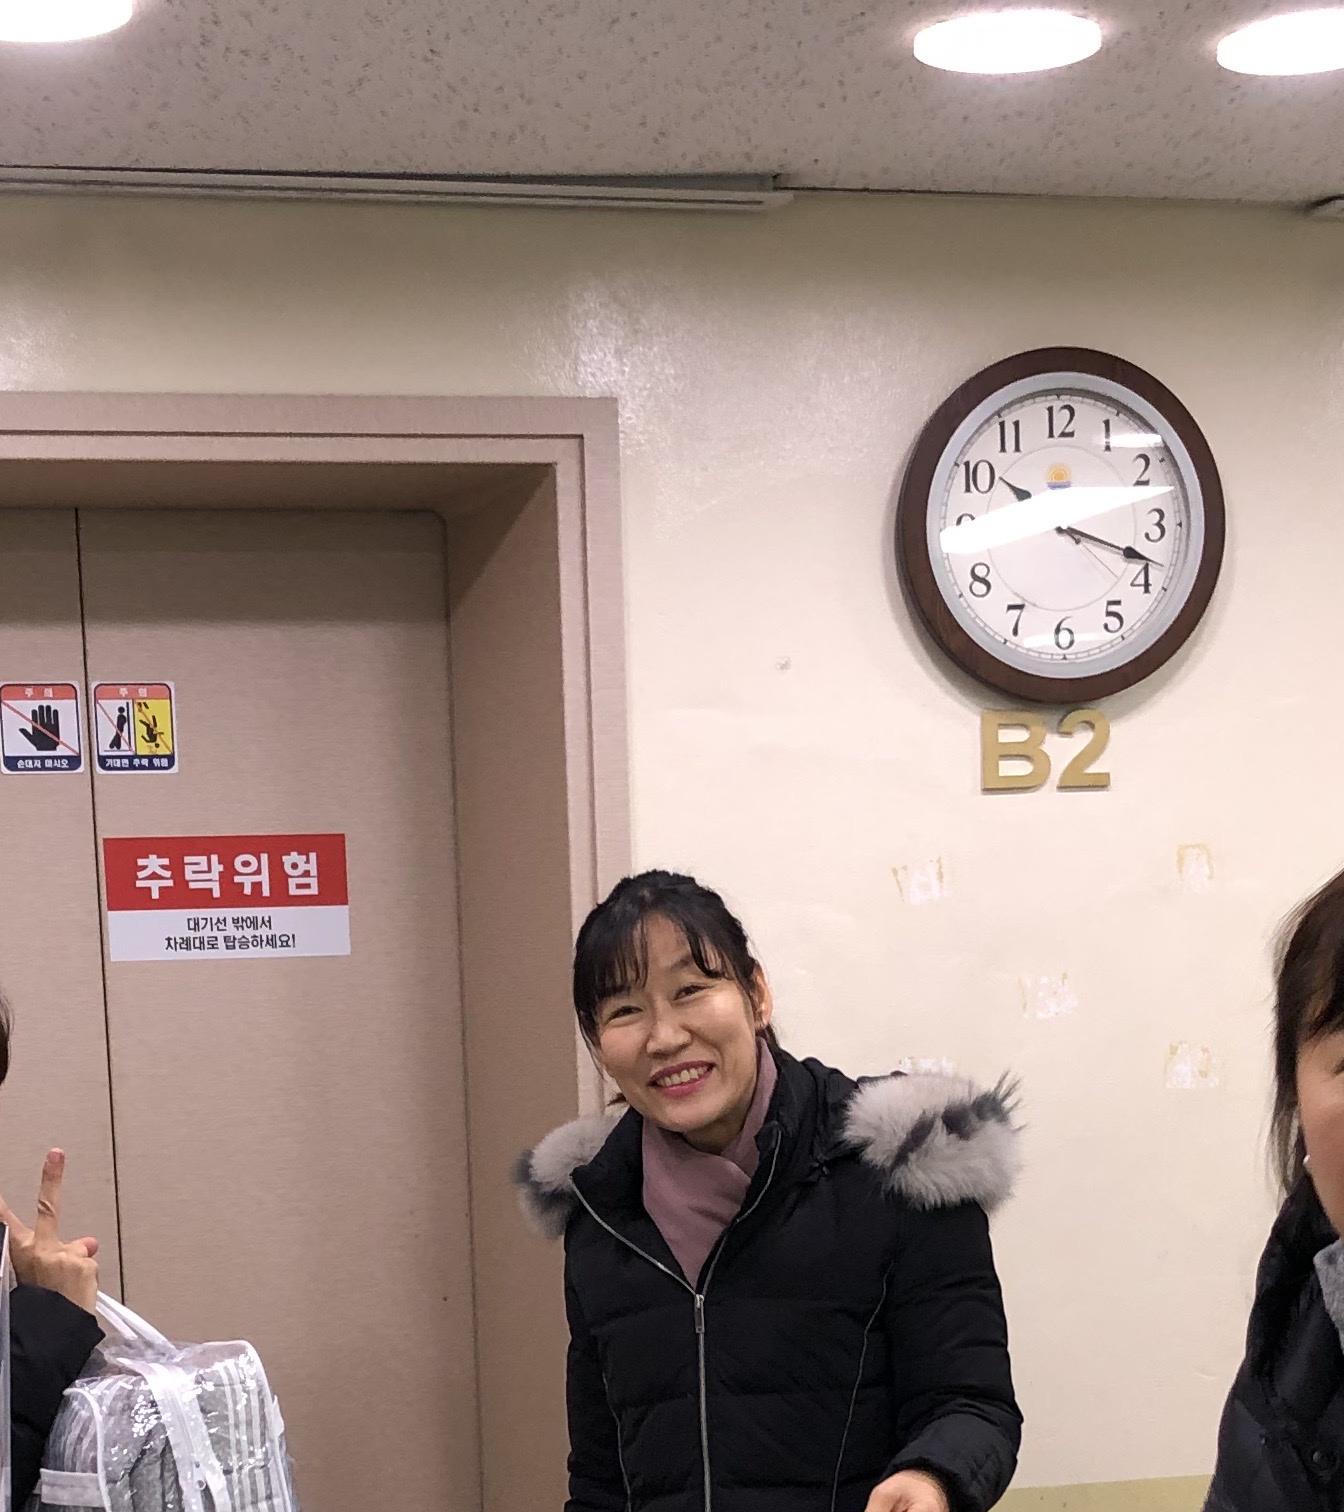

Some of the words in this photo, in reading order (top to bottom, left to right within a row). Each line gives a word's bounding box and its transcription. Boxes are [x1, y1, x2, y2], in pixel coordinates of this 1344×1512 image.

[998, 419, 1022, 453] 11
[1046, 404, 1076, 439] 12
[1102, 419, 1112, 451] 1
[962, 459, 996, 494] 10
[1132, 453, 1151, 486] 2
[1144, 508, 1166, 543] 3
[969, 562, 991, 598] 8
[1129, 562, 1152, 594] 4
[1006, 603, 1025, 637] 7
[1053, 616, 1074, 650] 6
[1103, 600, 1124, 633] 5
[980, 708, 1111, 794] B2
[135, 851, 319, 900] 추락위험
[187, 916, 227, 932] 대기선
[231, 915, 272, 931] 밖에서
[164, 935, 219, 952] 차례대로
[224, 934, 296, 950] 탑승하세요!
